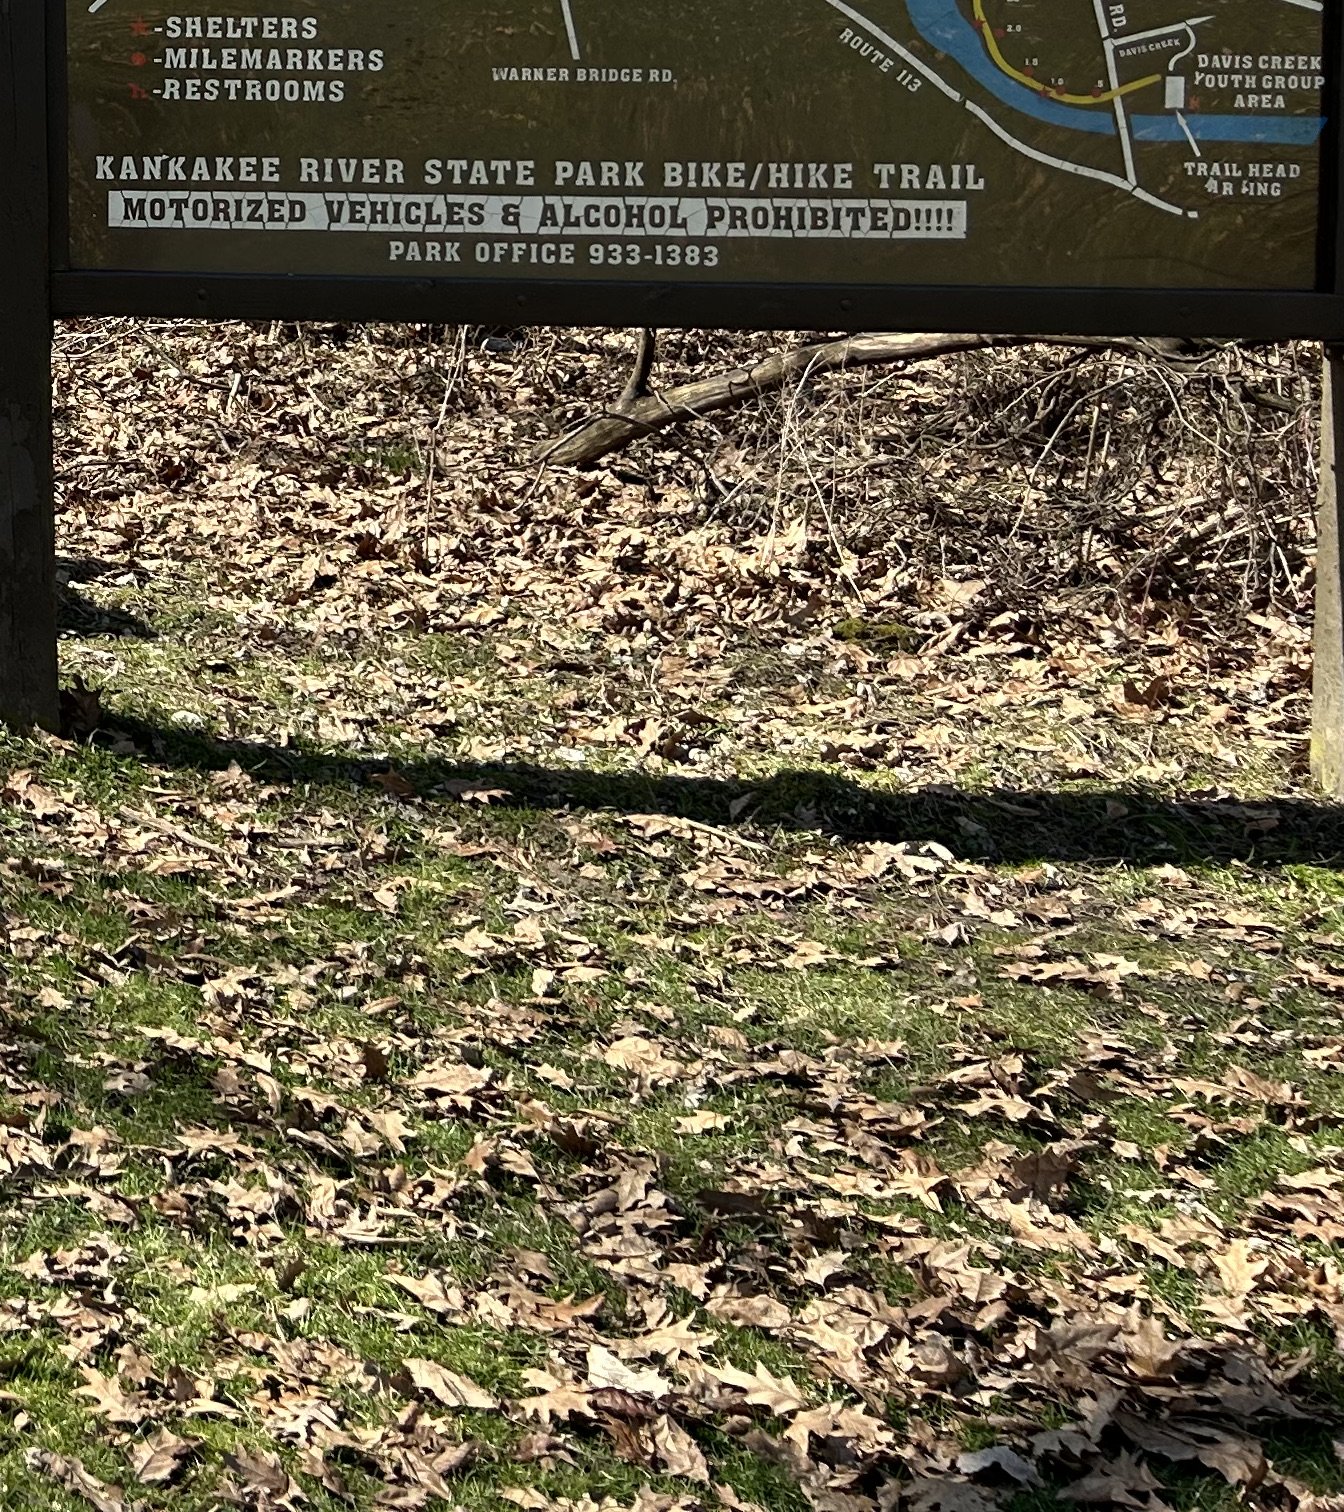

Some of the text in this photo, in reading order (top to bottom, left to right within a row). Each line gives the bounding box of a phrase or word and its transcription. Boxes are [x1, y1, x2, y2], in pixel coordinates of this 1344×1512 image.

[1109, 4, 1127, 32] RD.
[1119, 39, 1180, 57] DAVIS CREEK
[839, 28, 922, 92] ROUTE 113
[1197, 54, 1322, 69] DAVIS CREEK
[492, 67, 569, 81] WARNER
[576, 68, 643, 82] BRIDGE
[1194, 71, 1325, 89] YOUTH GROUP
[1234, 94, 1285, 108] AREA
[95, 155, 985, 190] KANKAKEE RIVER STATE PARK BIKE/HIKE TRAIL
[1183, 162, 1300, 177] TRAIL HEAD
[122, 197, 953, 232] MOTORIZED VEHICLES & ALCOHOL PROHIBITED!!!!
[389, 241, 719, 267] PARK OFFICE 933-1383
